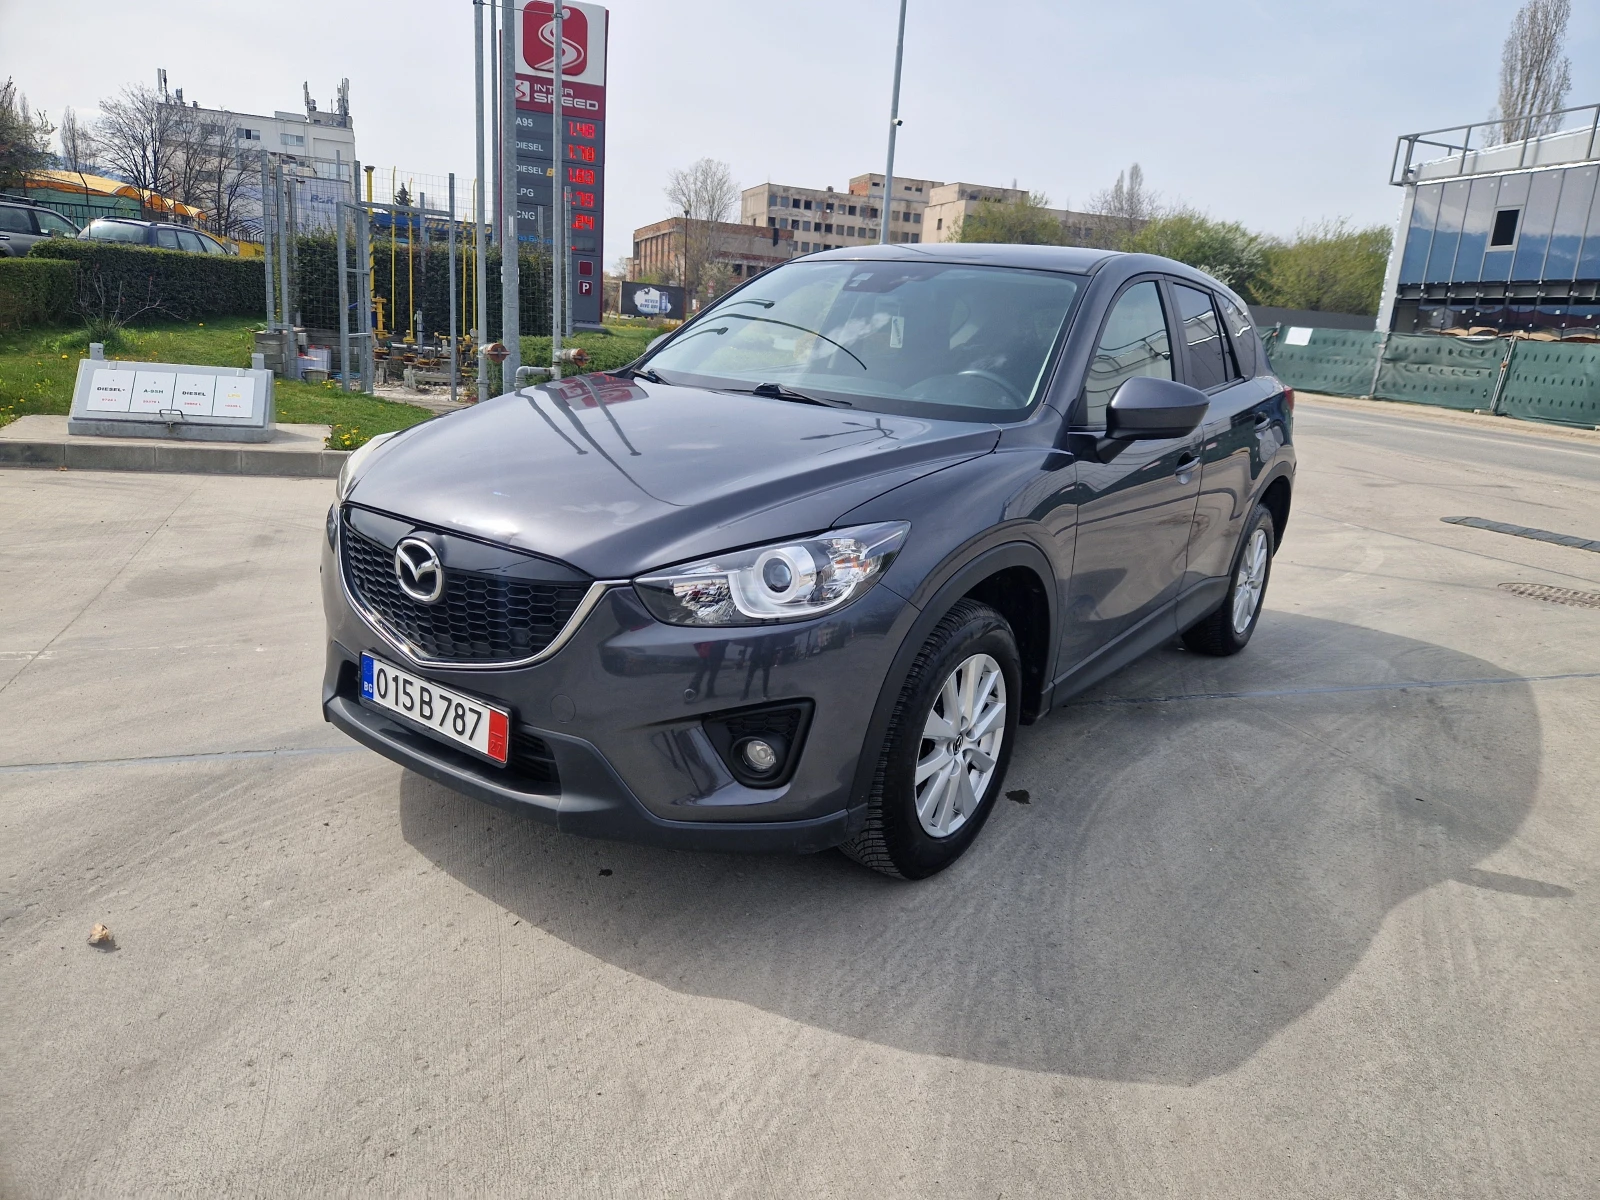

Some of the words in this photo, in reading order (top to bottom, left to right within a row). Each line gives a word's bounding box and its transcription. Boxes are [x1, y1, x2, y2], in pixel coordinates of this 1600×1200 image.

[534, 83, 574, 96] INTR
[515, 117, 534, 127] A95
[515, 141, 544, 152] DIESEL
[516, 164, 544, 175] DIESEL
[363, 681, 373, 693] BG
[376, 667, 482, 741] 015B787
